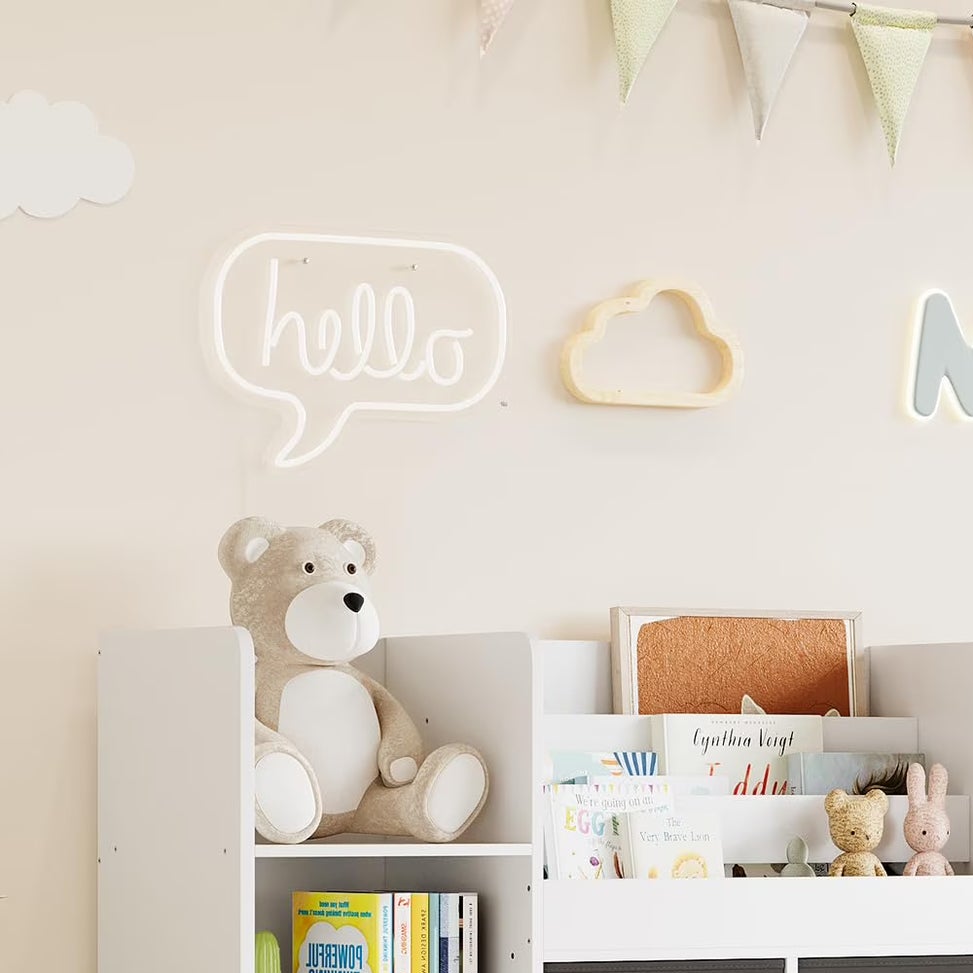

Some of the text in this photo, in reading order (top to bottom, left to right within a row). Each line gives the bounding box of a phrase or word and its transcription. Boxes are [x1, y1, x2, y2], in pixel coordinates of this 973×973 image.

[261, 257, 474, 386] hello
[693, 727, 795, 757] Cynthia Voigt
[575, 794, 598, 808] We're
[601, 798, 627, 811] going
[628, 797, 641, 806] on
[642, 796, 654, 805] an
[564, 806, 605, 836] EGG
[640, 831, 711, 845] Very Brave Lion
